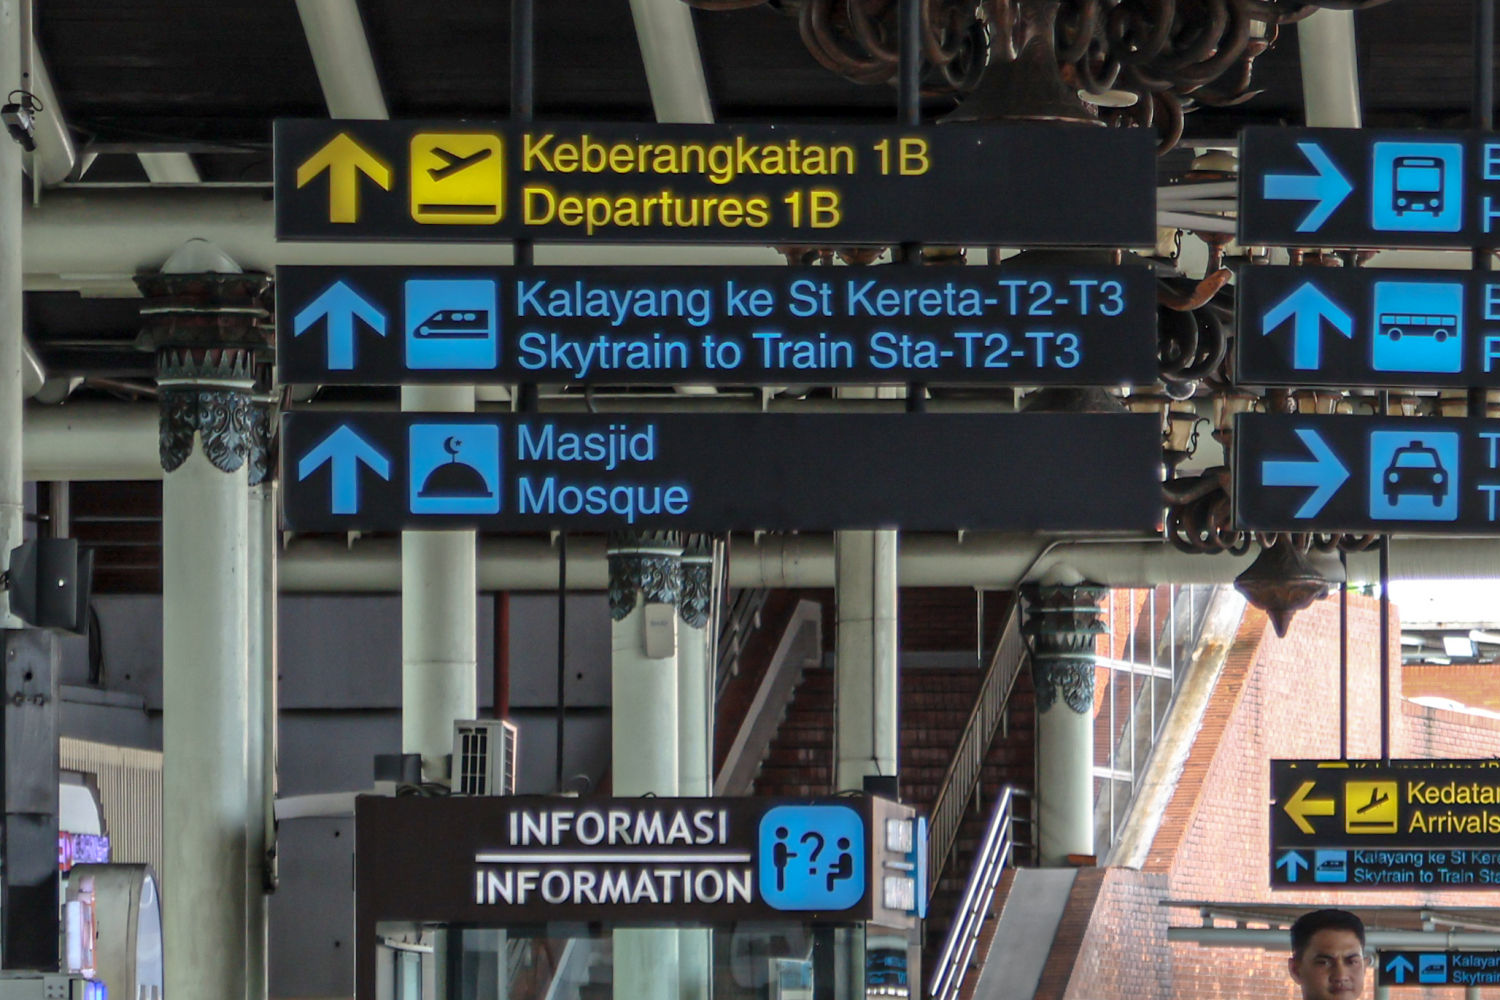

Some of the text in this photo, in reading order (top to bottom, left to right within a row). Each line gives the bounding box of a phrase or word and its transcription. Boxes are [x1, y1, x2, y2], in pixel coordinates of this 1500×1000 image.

[523, 134, 930, 184] Keberangkatan 1B
[523, 188, 840, 234] Departures 1B
[517, 279, 1125, 326] Kalayang ke St Kereta-T2-T3
[518, 331, 1080, 379] Skytrain to Train Sta-T2-T3
[518, 424, 654, 469] Masjid
[519, 477, 690, 523] Mosque
[509, 810, 727, 846] INFORMASI
[1353, 849, 1424, 869] Kalayang
[1428, 849, 1446, 865] ke
[1450, 849, 1467, 865] St
[1353, 869, 1414, 885] Skytrain
[1419, 869, 1433, 883] to
[1437, 869, 1474, 883] Train
[475, 869, 753, 904] INFORMATION
